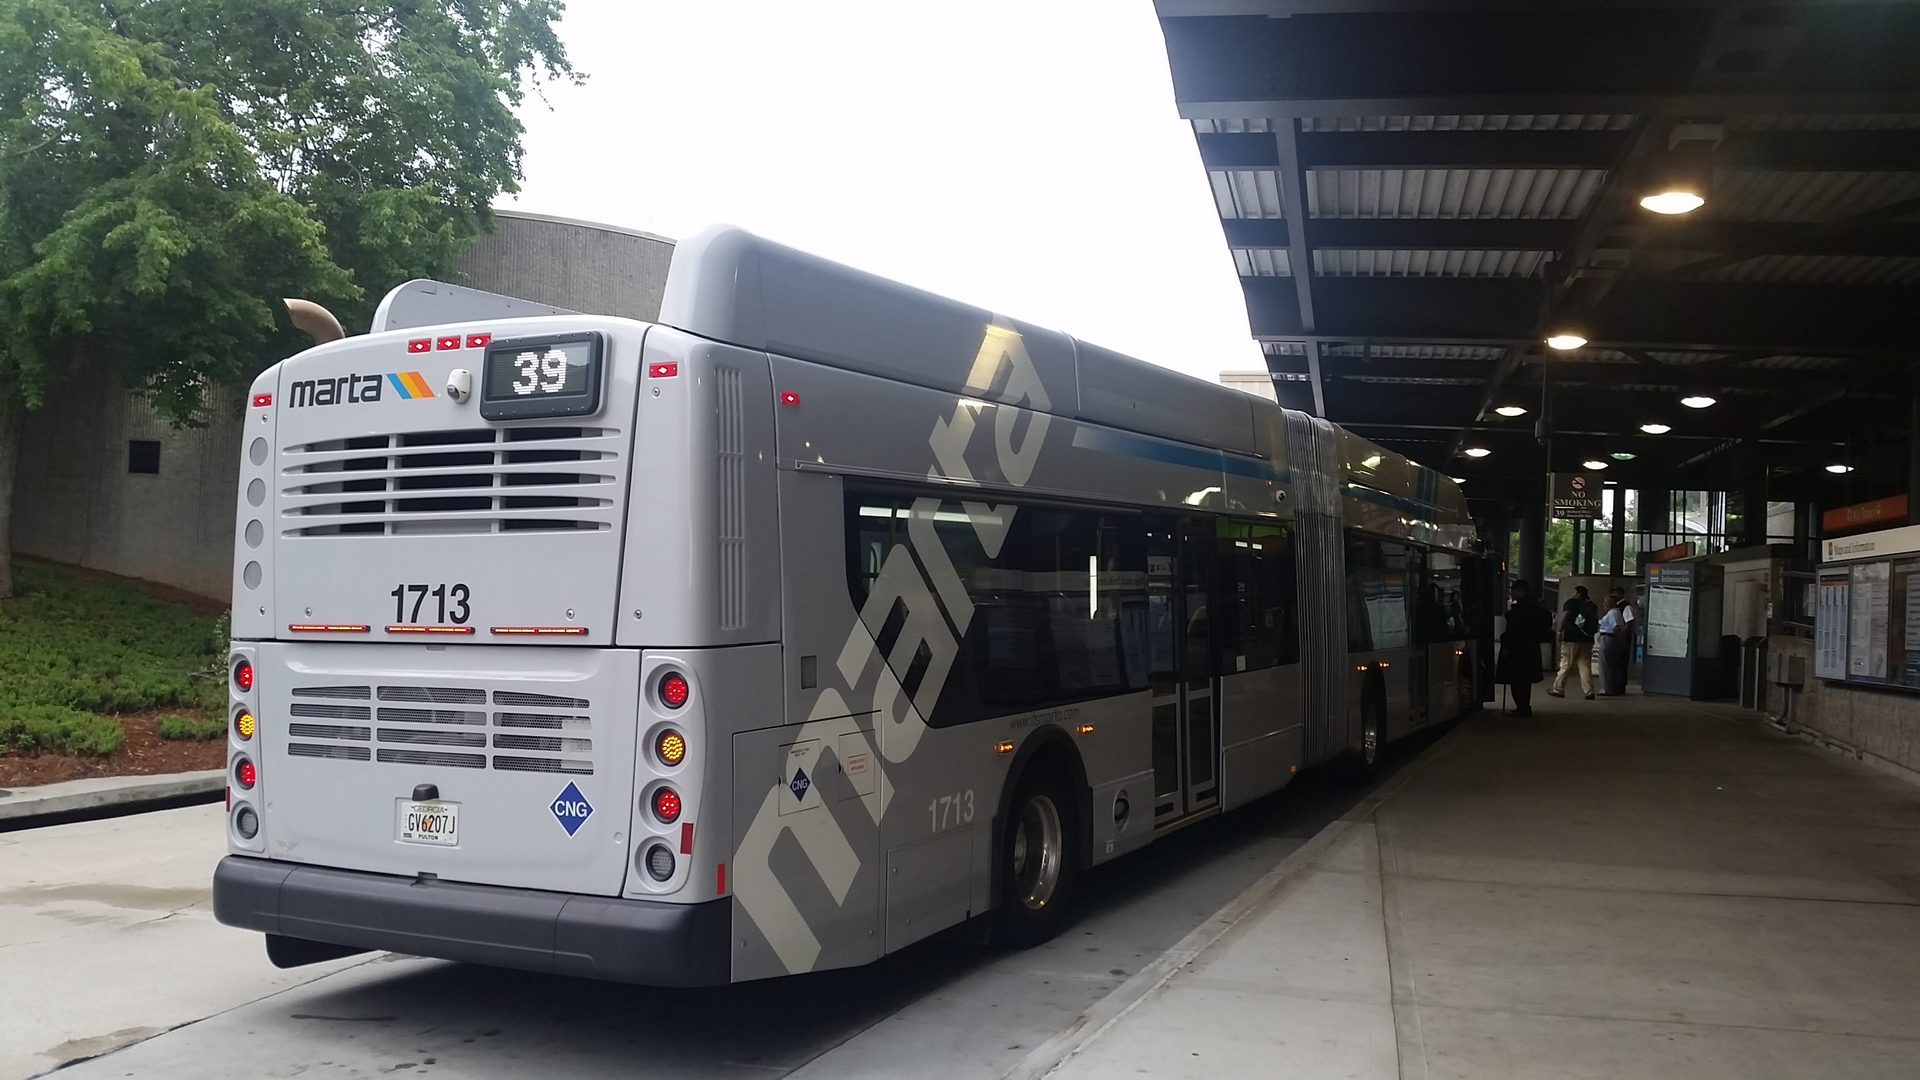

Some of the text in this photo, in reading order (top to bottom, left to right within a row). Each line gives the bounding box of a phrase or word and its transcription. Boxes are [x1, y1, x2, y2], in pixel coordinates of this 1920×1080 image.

[512, 349, 567, 395] 39
[289, 373, 383, 408] marta
[1554, 498, 1602, 507] SMOKING
[1571, 490, 1586, 499] NO
[1554, 509, 1565, 518] 39
[390, 583, 470, 624] 1713
[733, 312, 1052, 974] marta
[1009, 707, 1080, 731] www.itsmarta.com
[791, 778, 808, 791] CNG
[413, 804, 445, 814] GEORGIA
[554, 800, 587, 818] CNG
[929, 789, 975, 833] 1713
[408, 813, 456, 835] GV6207J
[418, 833, 439, 841] FULTON
